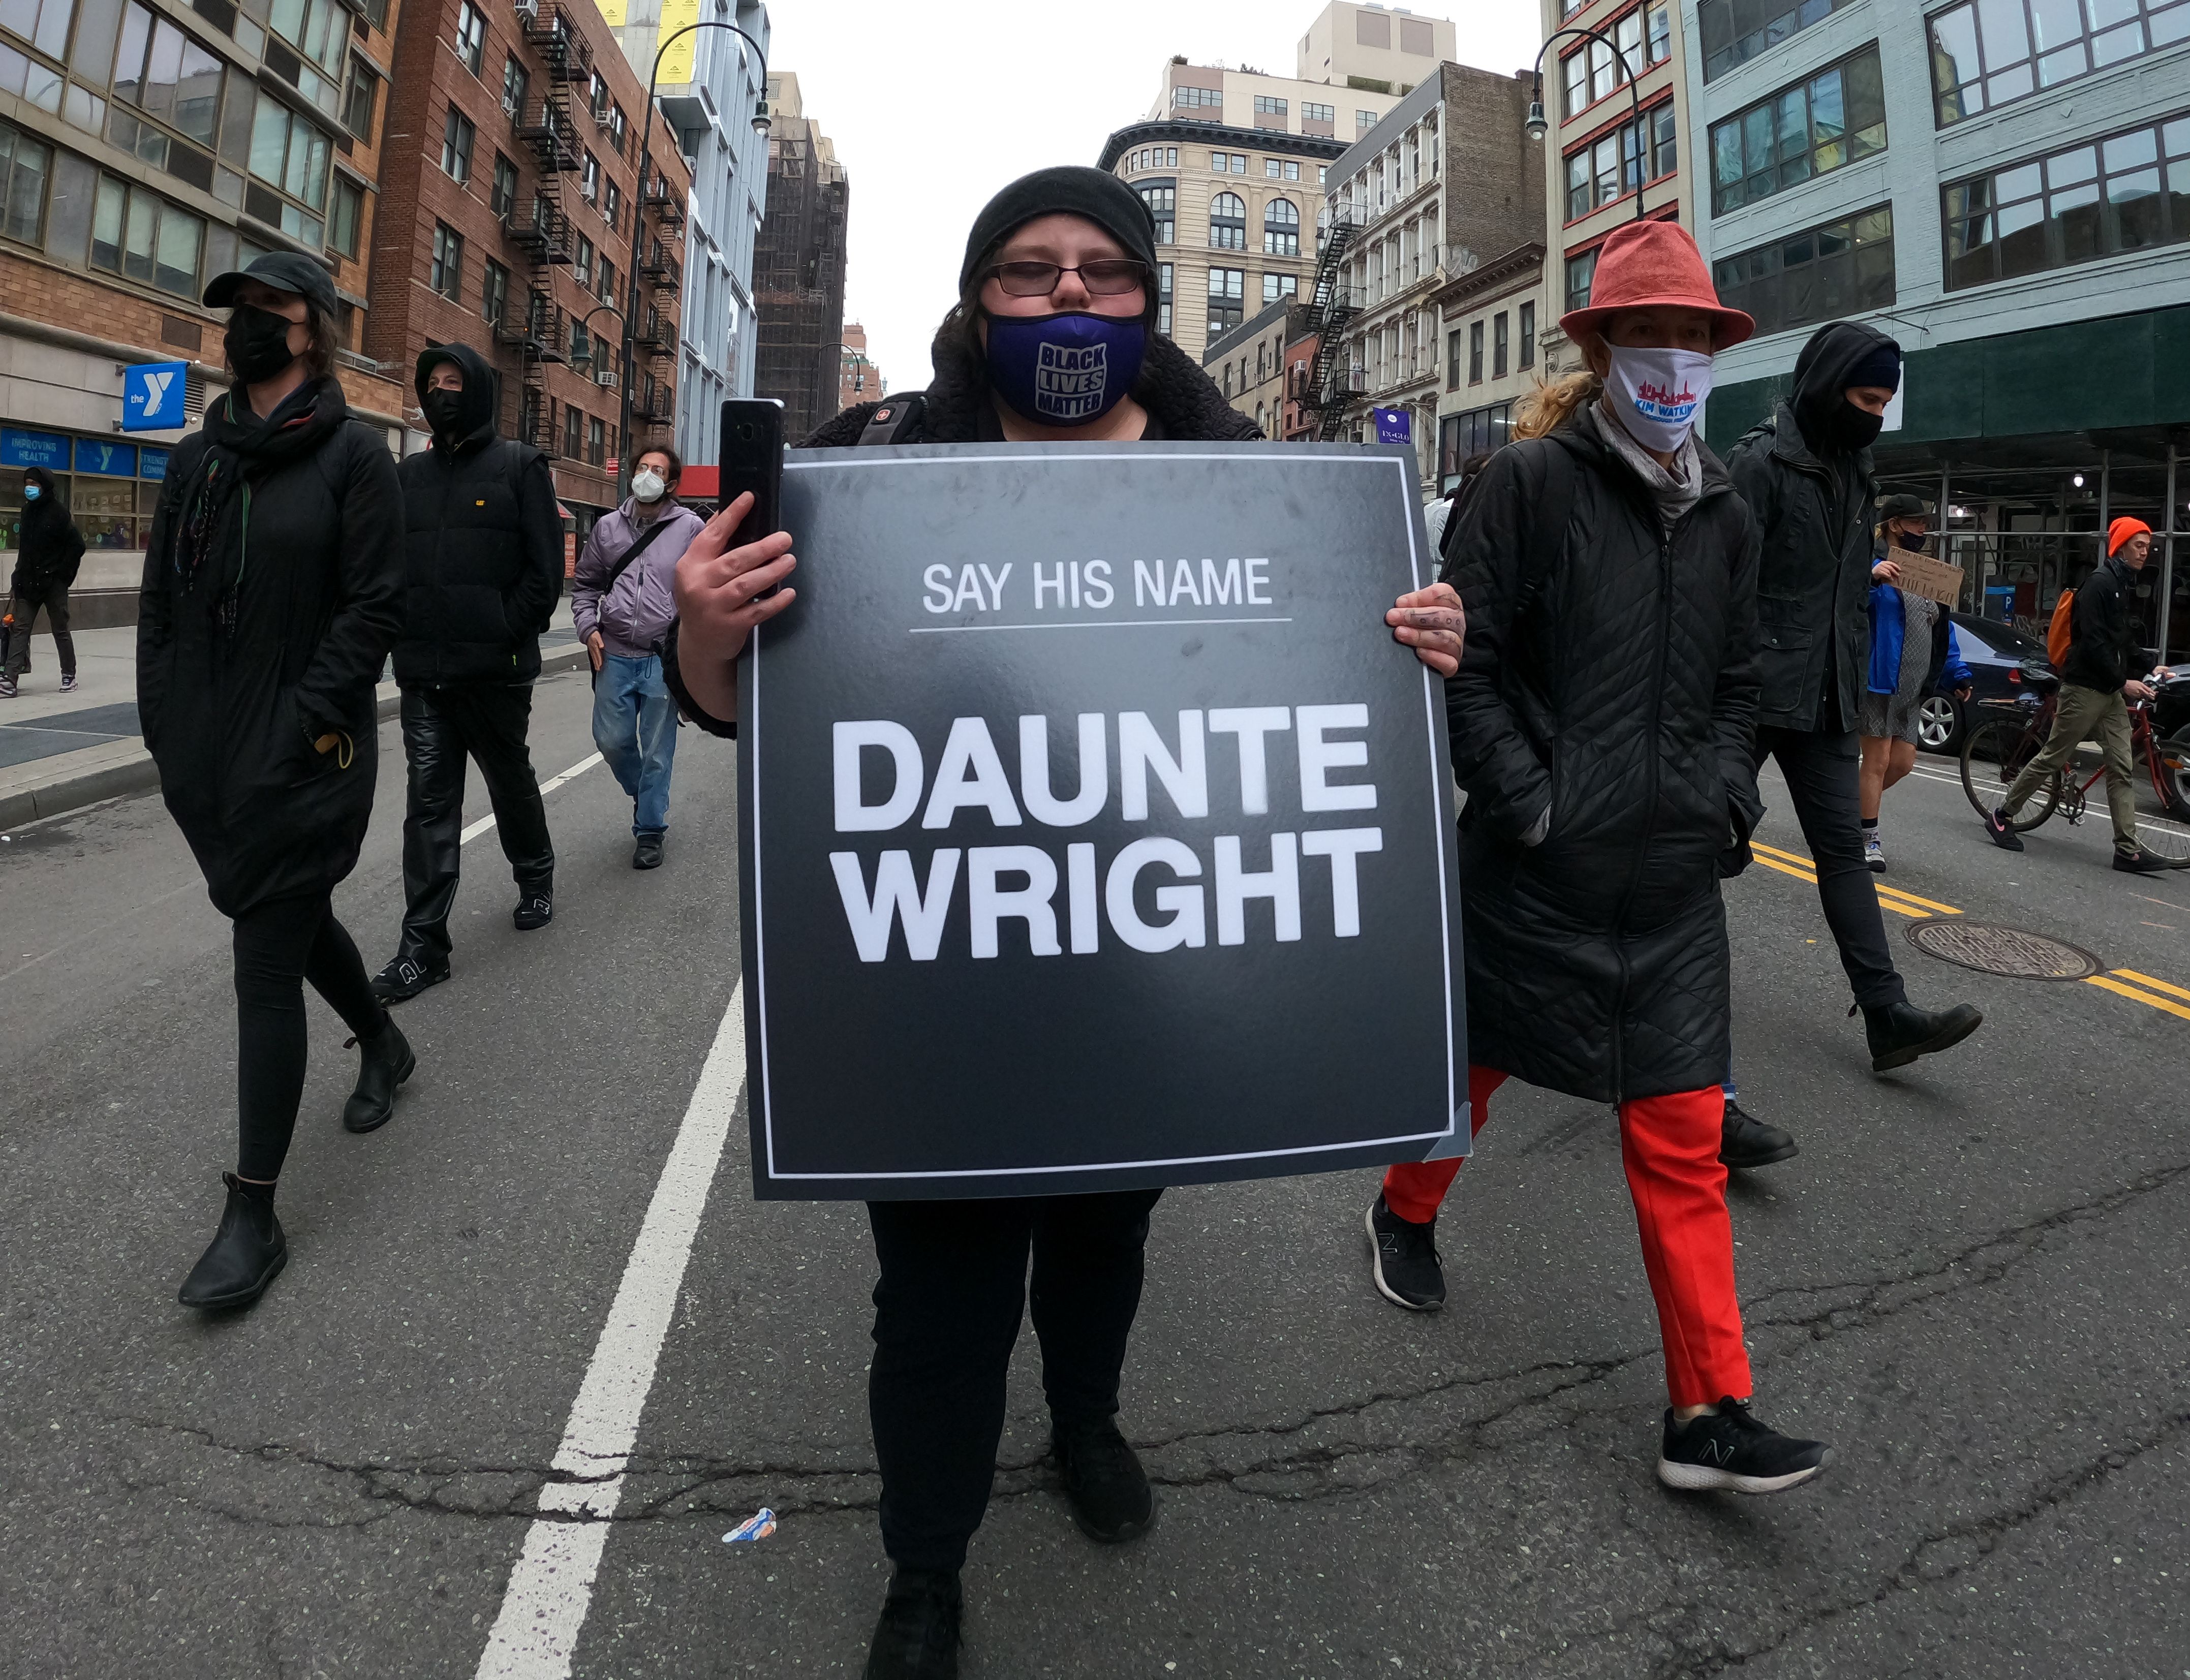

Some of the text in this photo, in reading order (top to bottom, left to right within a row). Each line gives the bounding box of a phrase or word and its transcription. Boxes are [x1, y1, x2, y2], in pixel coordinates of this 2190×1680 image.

[1041, 346, 1104, 370] BLACK
[1040, 370, 1103, 392] LIVES
[131, 372, 173, 416] the Y
[1038, 392, 1101, 415] MATTER
[1634, 399, 1655, 413] KIM
[11, 437, 56, 453] IMPROVING
[18, 450, 49, 462] HEALTH
[922, 558, 1273, 613] SAY HIS NAME
[2006, 596, 2012, 609] P
[832, 703, 1378, 832] DAUNTE
[829, 827, 1383, 962] WRIGHT
